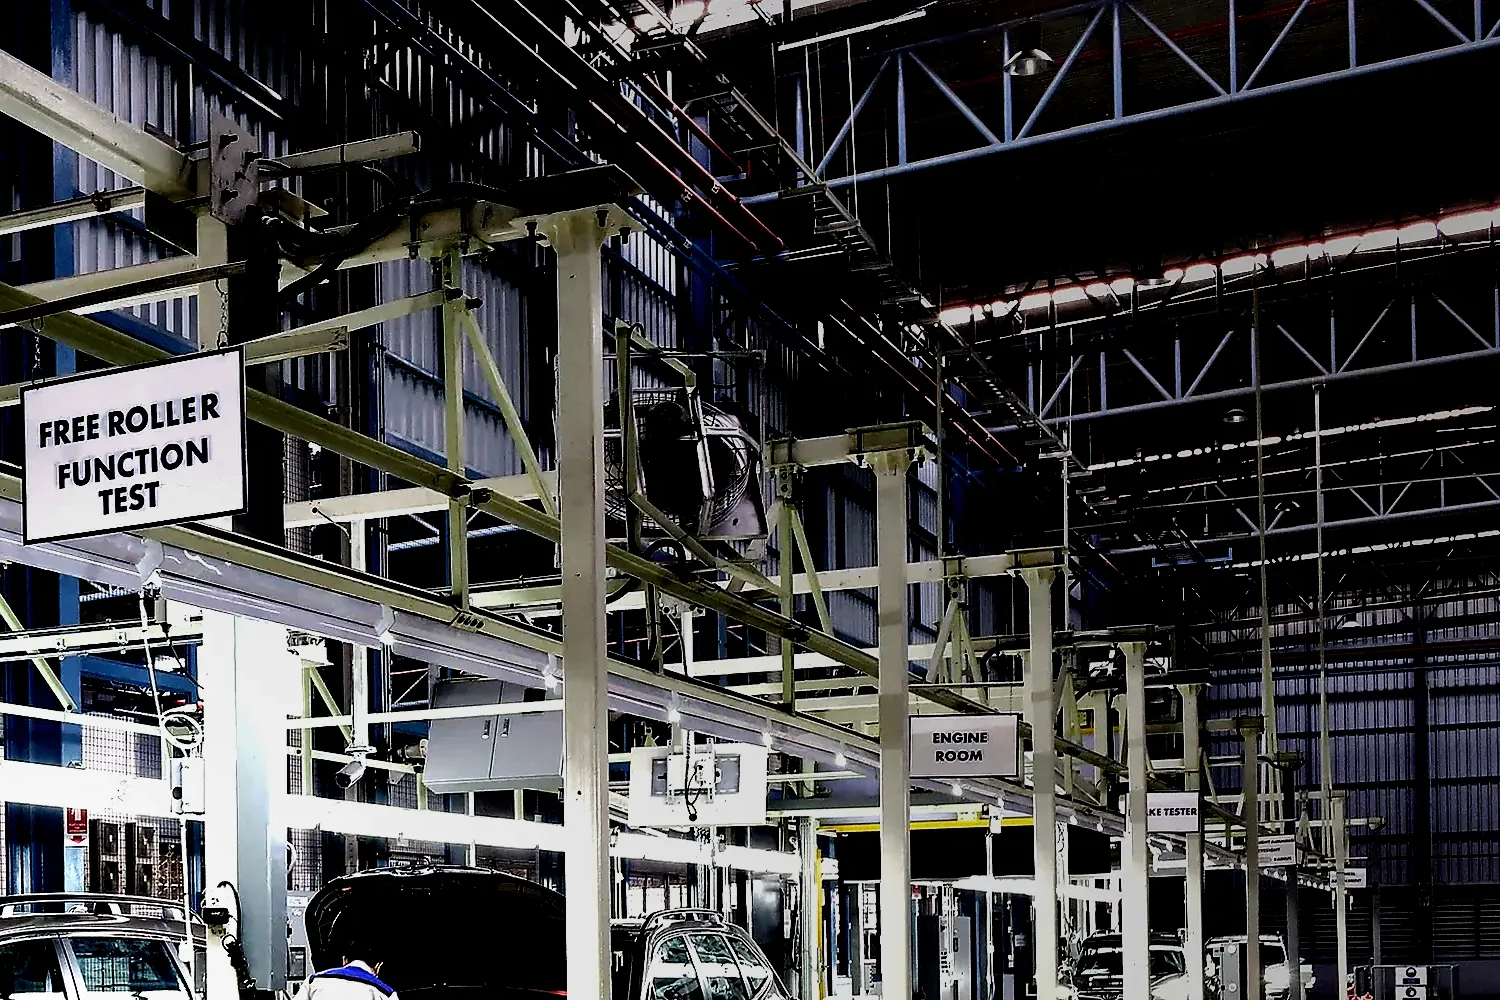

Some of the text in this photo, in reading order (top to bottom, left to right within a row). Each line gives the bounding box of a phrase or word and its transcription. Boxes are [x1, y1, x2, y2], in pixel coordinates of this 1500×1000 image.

[39, 393, 221, 449] FREE ROLLER
[57, 437, 209, 489] FUNCTION
[98, 481, 160, 515] TEST
[932, 732, 988, 744] ENGINE
[935, 750, 983, 762] ROOM
[1163, 807, 1198, 816] TESTER
